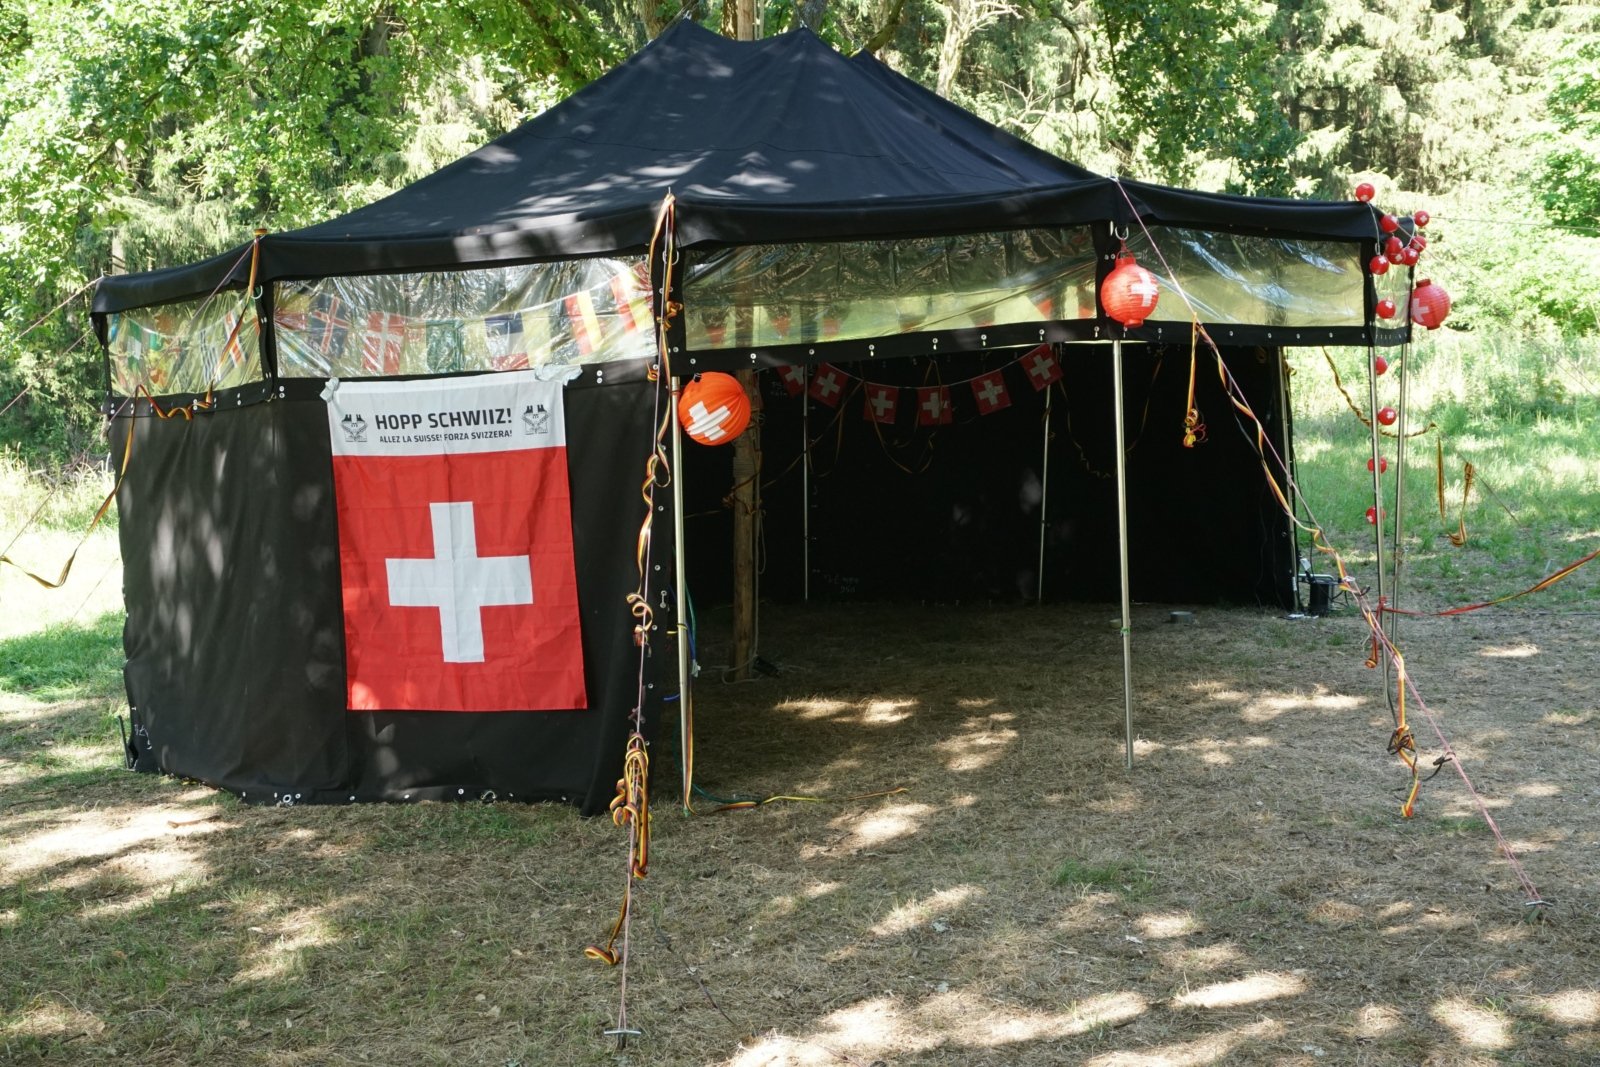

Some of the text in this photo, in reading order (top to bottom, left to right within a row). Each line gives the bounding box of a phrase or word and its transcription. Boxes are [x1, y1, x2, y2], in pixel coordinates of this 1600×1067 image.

[375, 408, 512, 430] HOPP SCHWIIZ!
[380, 430, 512, 443] ALLEZ LA SUISSE! FORZA SVIZZERA!
